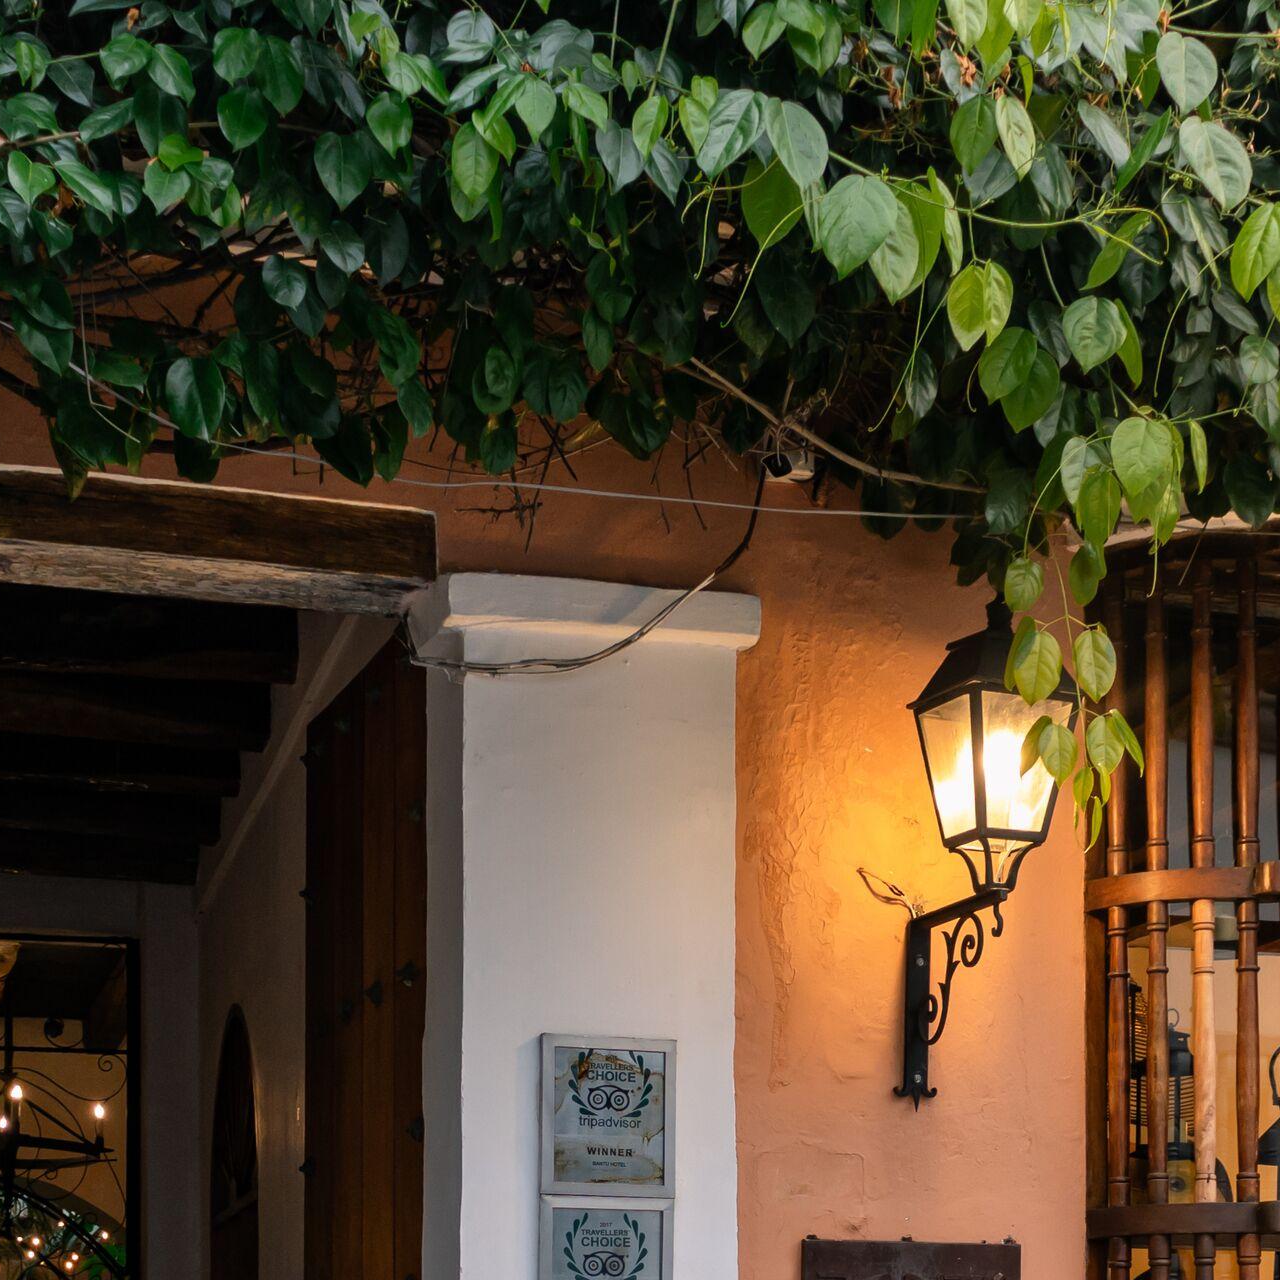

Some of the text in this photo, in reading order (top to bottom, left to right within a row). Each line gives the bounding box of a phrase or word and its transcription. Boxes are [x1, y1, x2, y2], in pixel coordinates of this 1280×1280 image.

[586, 1070, 637, 1083] CHOICE
[578, 1115, 642, 1129] tripadvisor
[587, 1146, 633, 1157] WINNER
[581, 1236, 631, 1248] CHOICE
